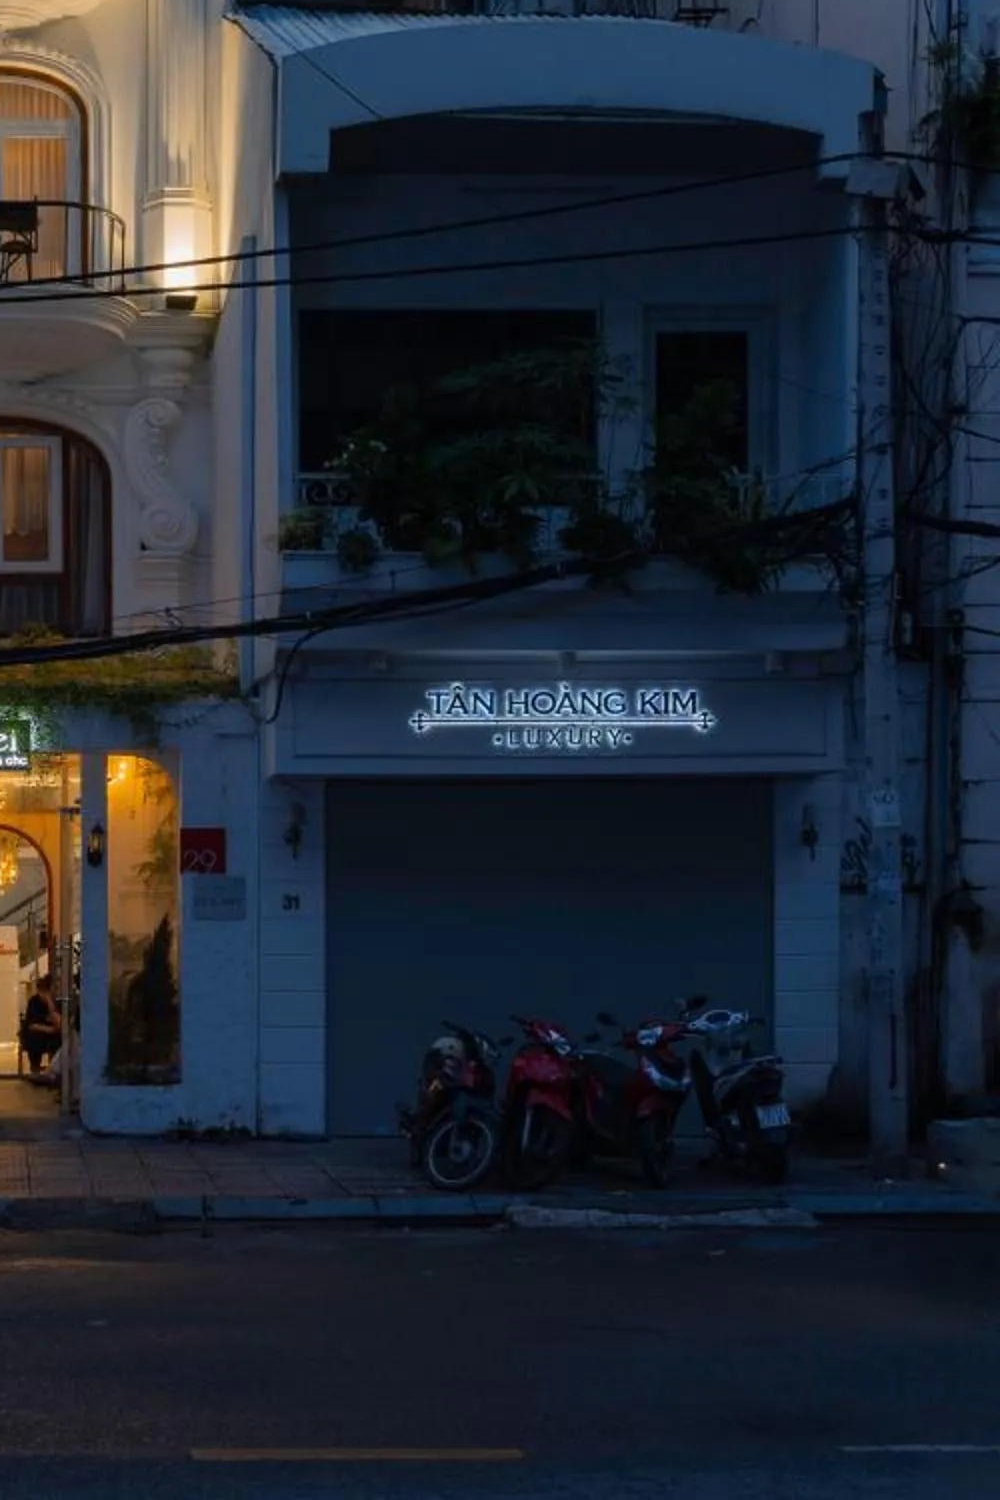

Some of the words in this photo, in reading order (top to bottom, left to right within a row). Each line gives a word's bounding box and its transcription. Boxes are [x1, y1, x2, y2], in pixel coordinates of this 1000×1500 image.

[427, 683, 495, 715] TÂN
[506, 683, 627, 715] HOÀNG
[638, 690, 699, 715] KIM
[507, 729, 623, 747] LUXURY
